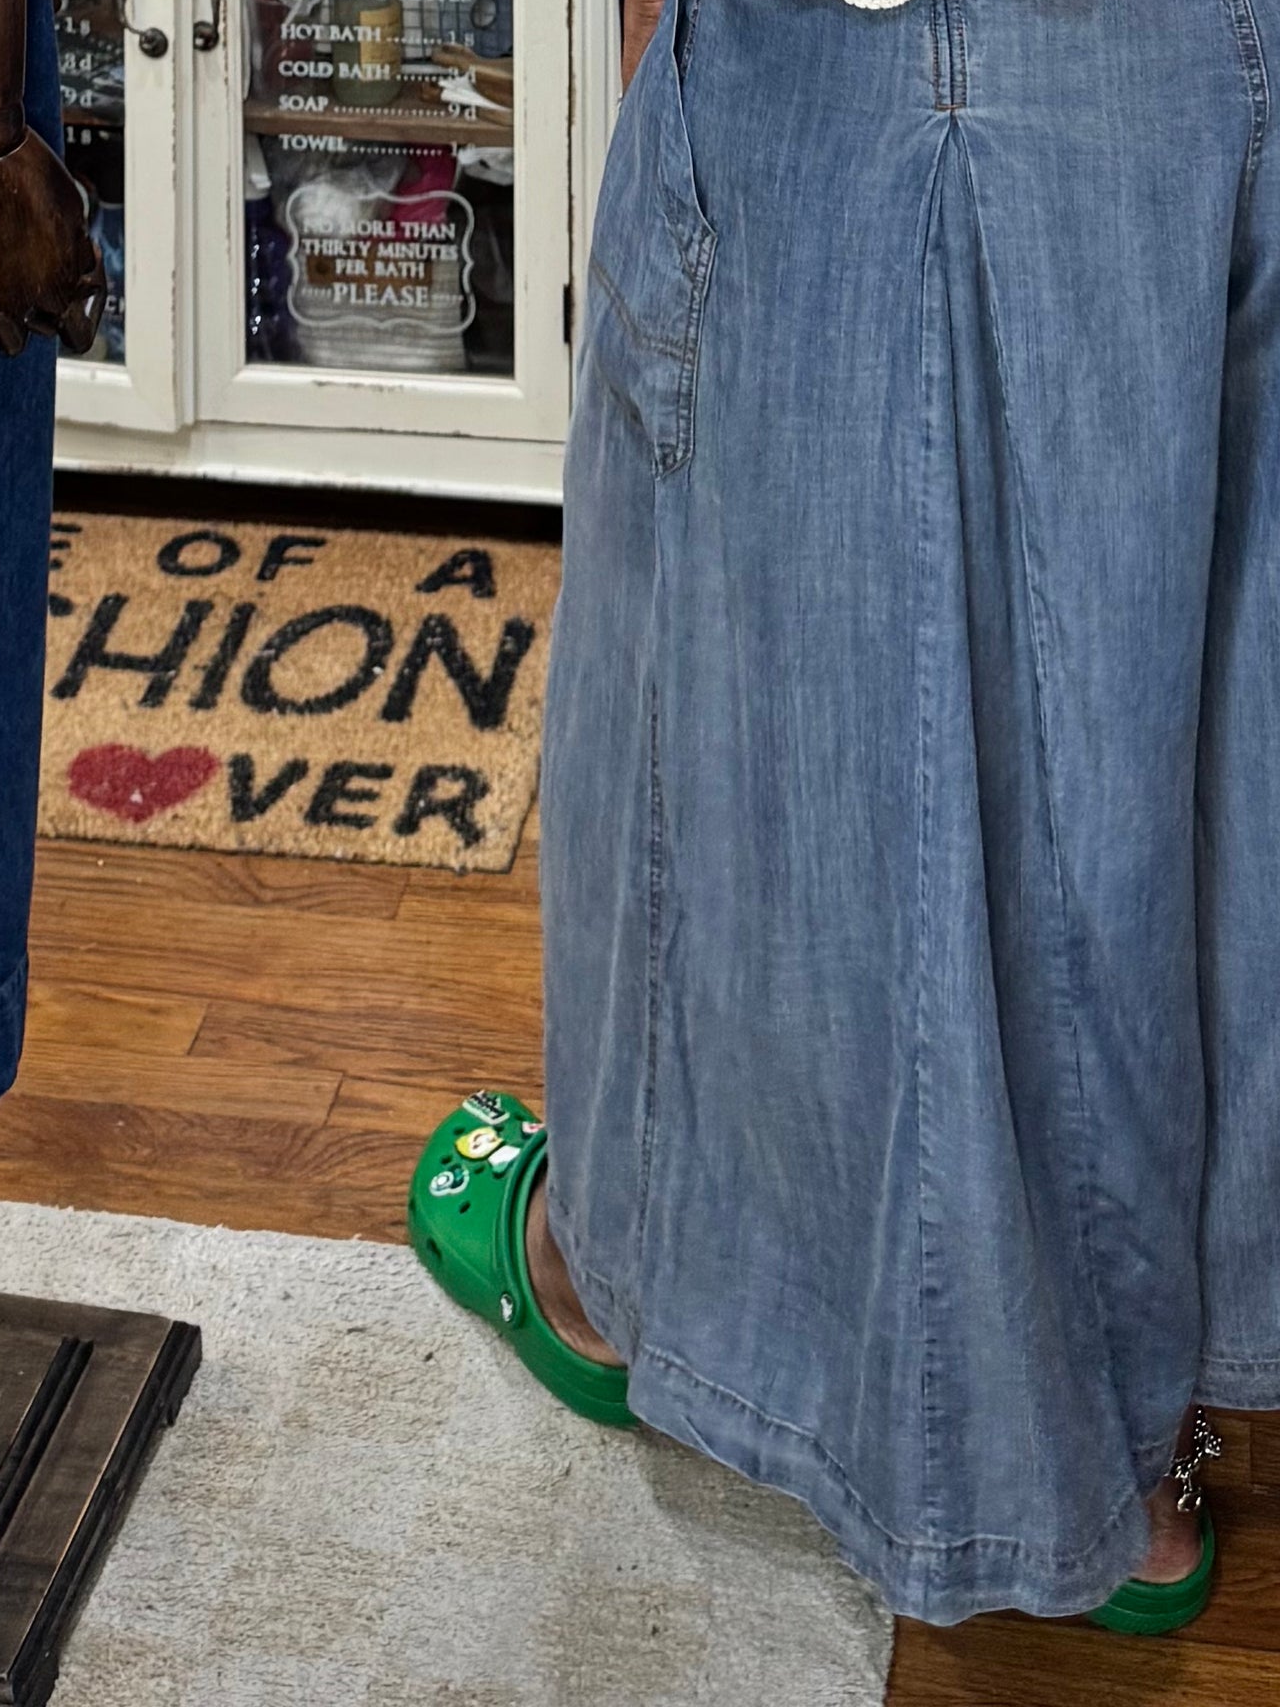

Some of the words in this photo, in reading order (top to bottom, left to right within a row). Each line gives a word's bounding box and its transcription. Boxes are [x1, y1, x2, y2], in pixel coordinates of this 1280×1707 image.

[280, 23, 324, 41] HOT
[330, 24, 382, 43] BATH
[278, 60, 334, 78] COLD
[338, 62, 391, 82] BATH
[278, 94, 330, 114] SOAP
[278, 133, 348, 153] TOWEL
[302, 217, 334, 234] NO
[339, 219, 396, 238] MORE
[401, 221, 456, 240] THAN
[301, 238, 371, 257] THIRTY
[376, 241, 459, 261] MINUTES
[335, 258, 368, 276] PER
[374, 260, 425, 279] BATH
[332, 282, 430, 308] PLEASE
[156, 529, 326, 582] OF
[416, 548, 497, 599] A
[48, 592, 536, 732] HION
